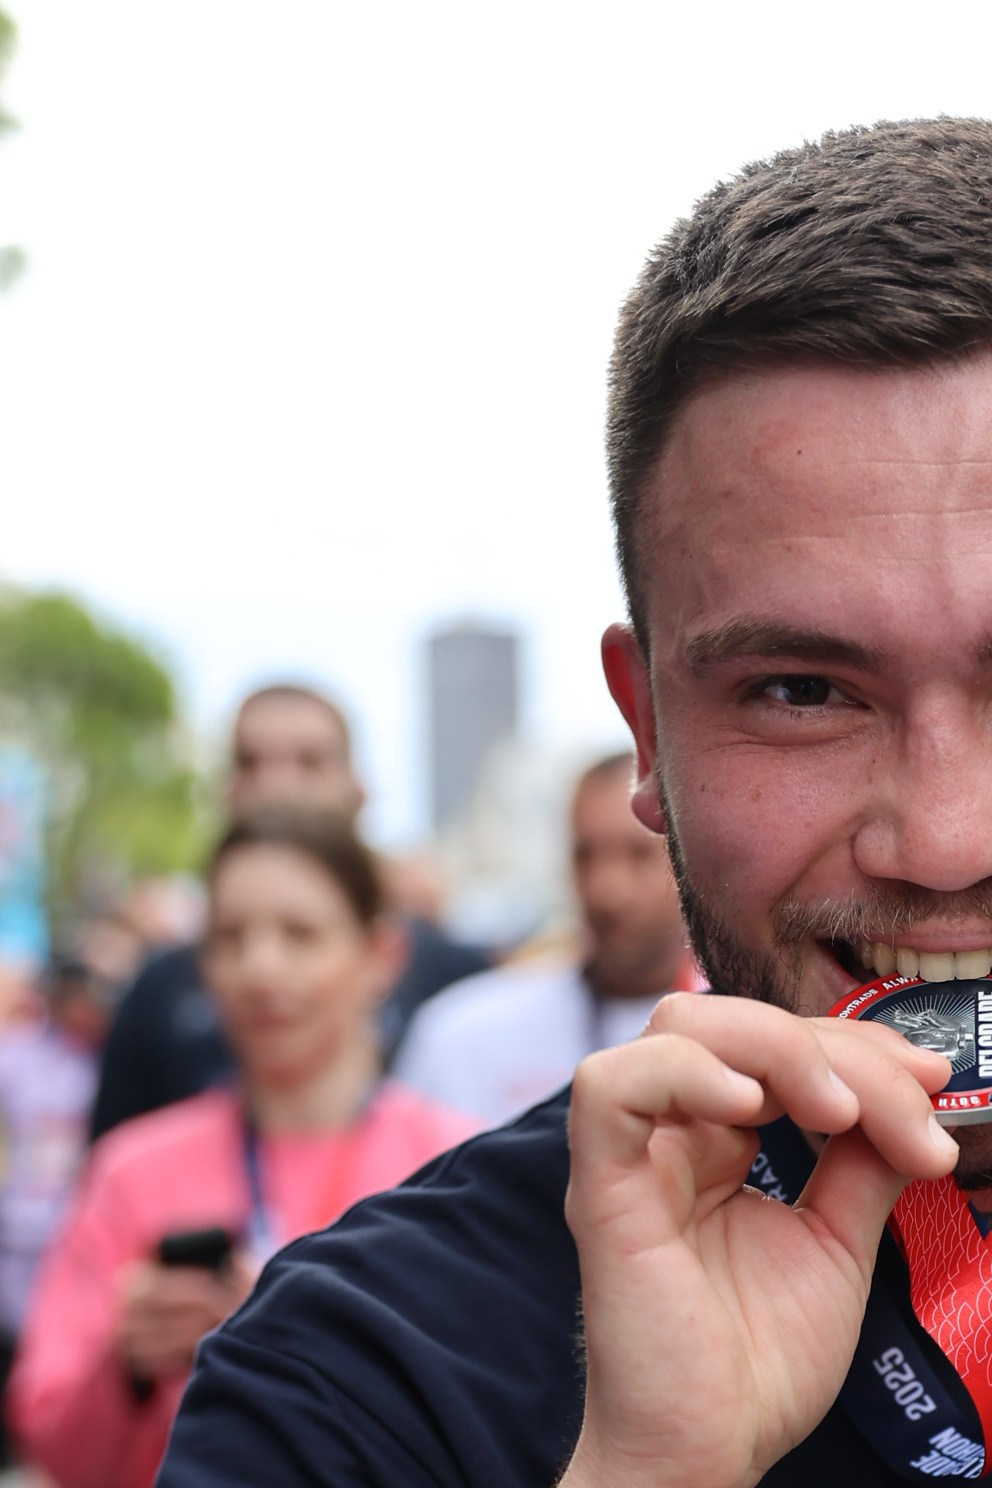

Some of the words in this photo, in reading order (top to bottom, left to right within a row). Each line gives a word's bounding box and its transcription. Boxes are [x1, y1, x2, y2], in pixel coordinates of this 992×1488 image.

[837, 988, 879, 1020] OMTRADE
[882, 975, 919, 990] ALW
[872, 1347, 937, 1421] 2025
